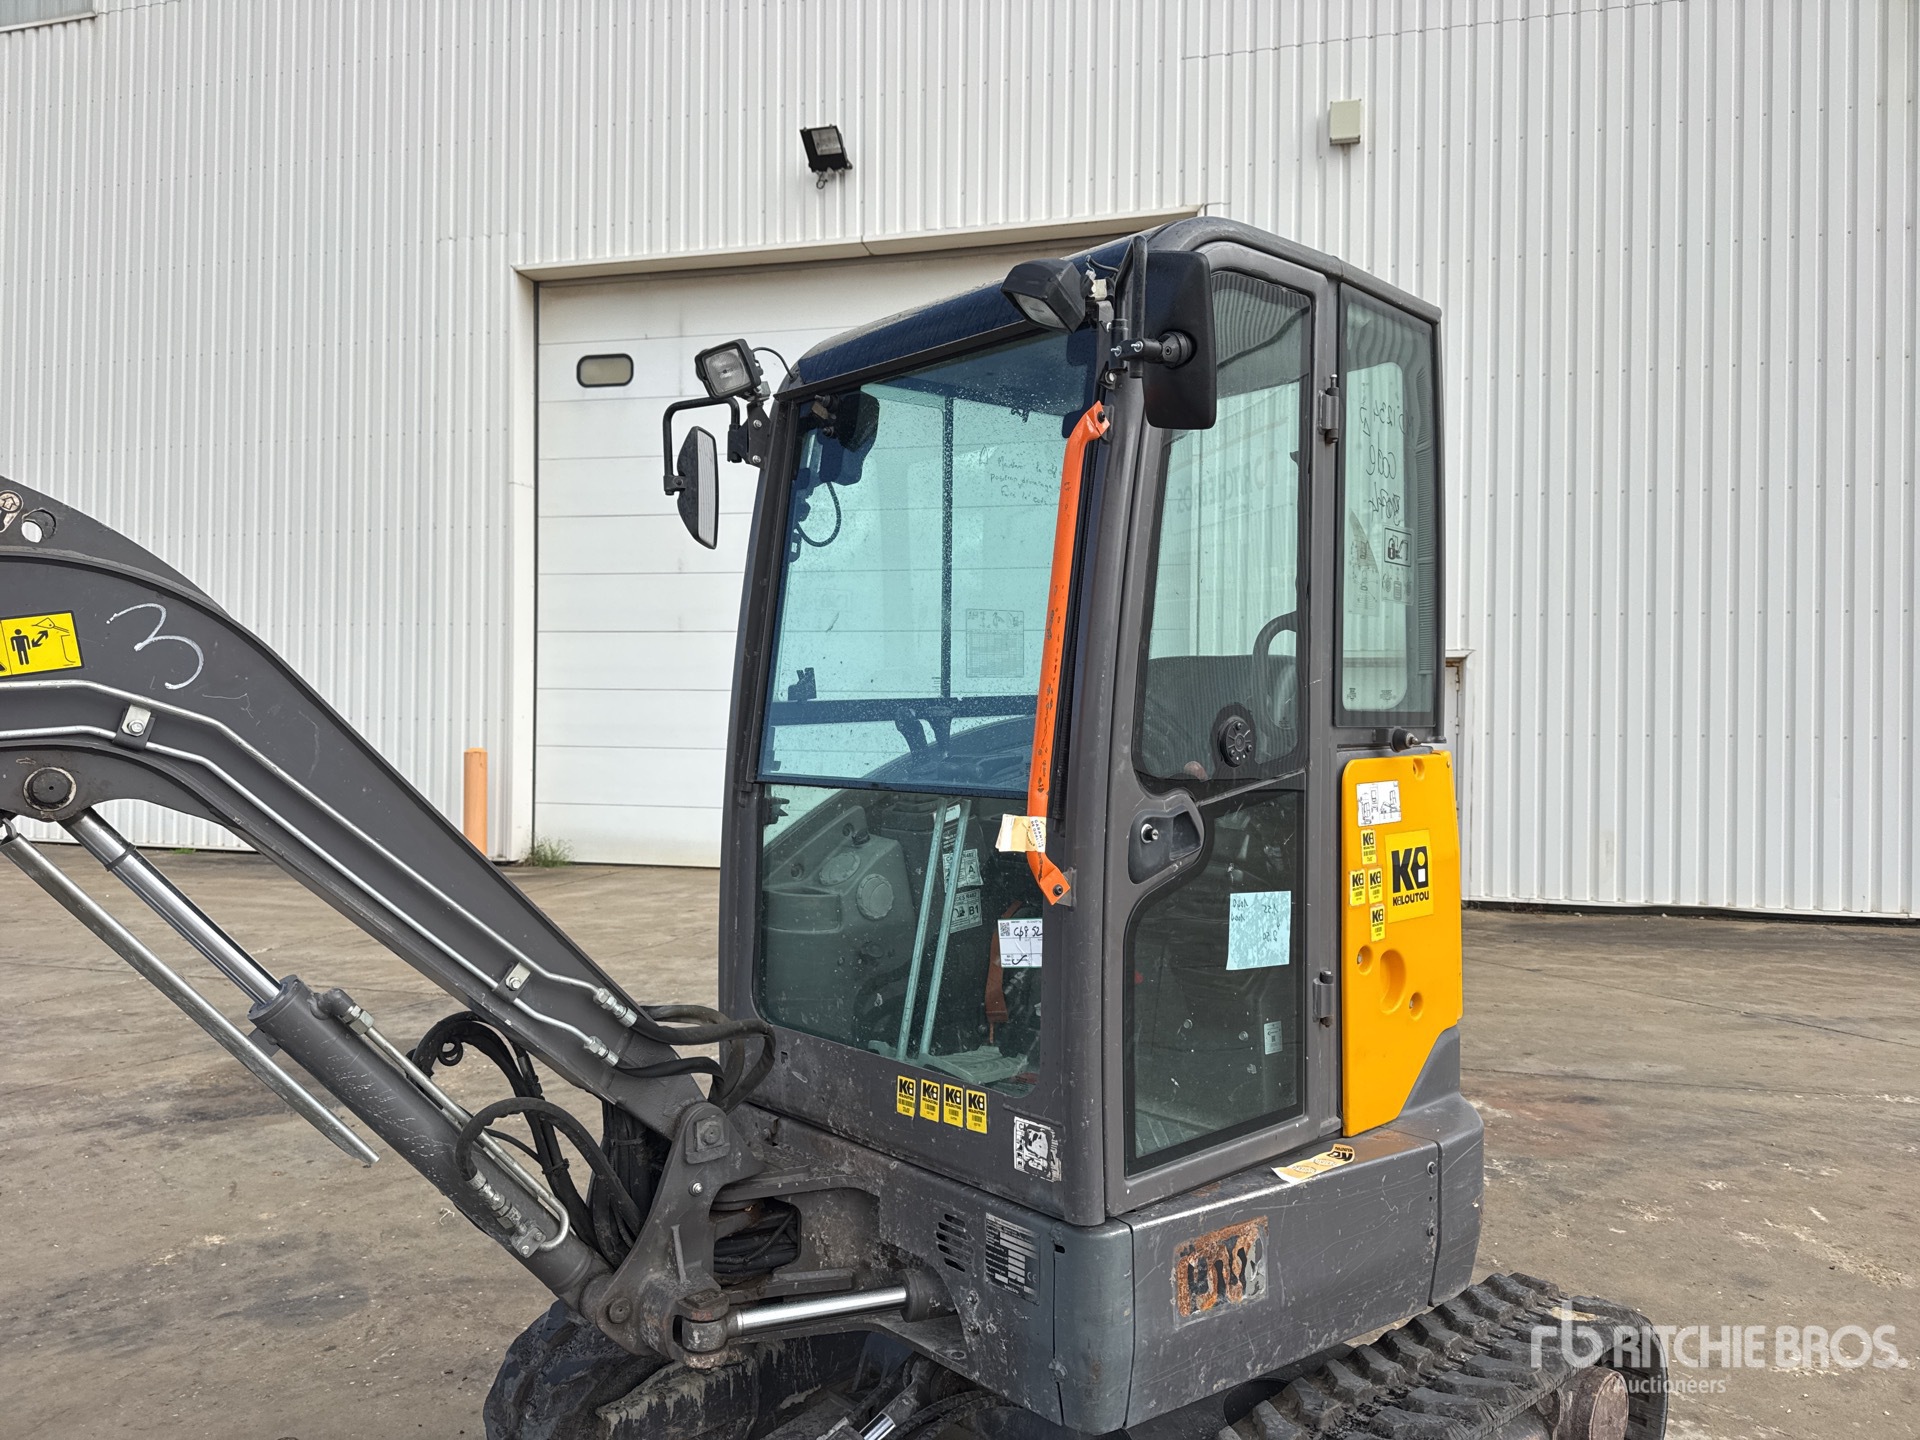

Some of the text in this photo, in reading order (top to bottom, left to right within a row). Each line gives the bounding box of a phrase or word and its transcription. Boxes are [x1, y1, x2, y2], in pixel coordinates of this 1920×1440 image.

[106, 603, 204, 690] 3
[1393, 891, 1429, 906] KILOUTOU
[968, 905, 979, 915] B1
